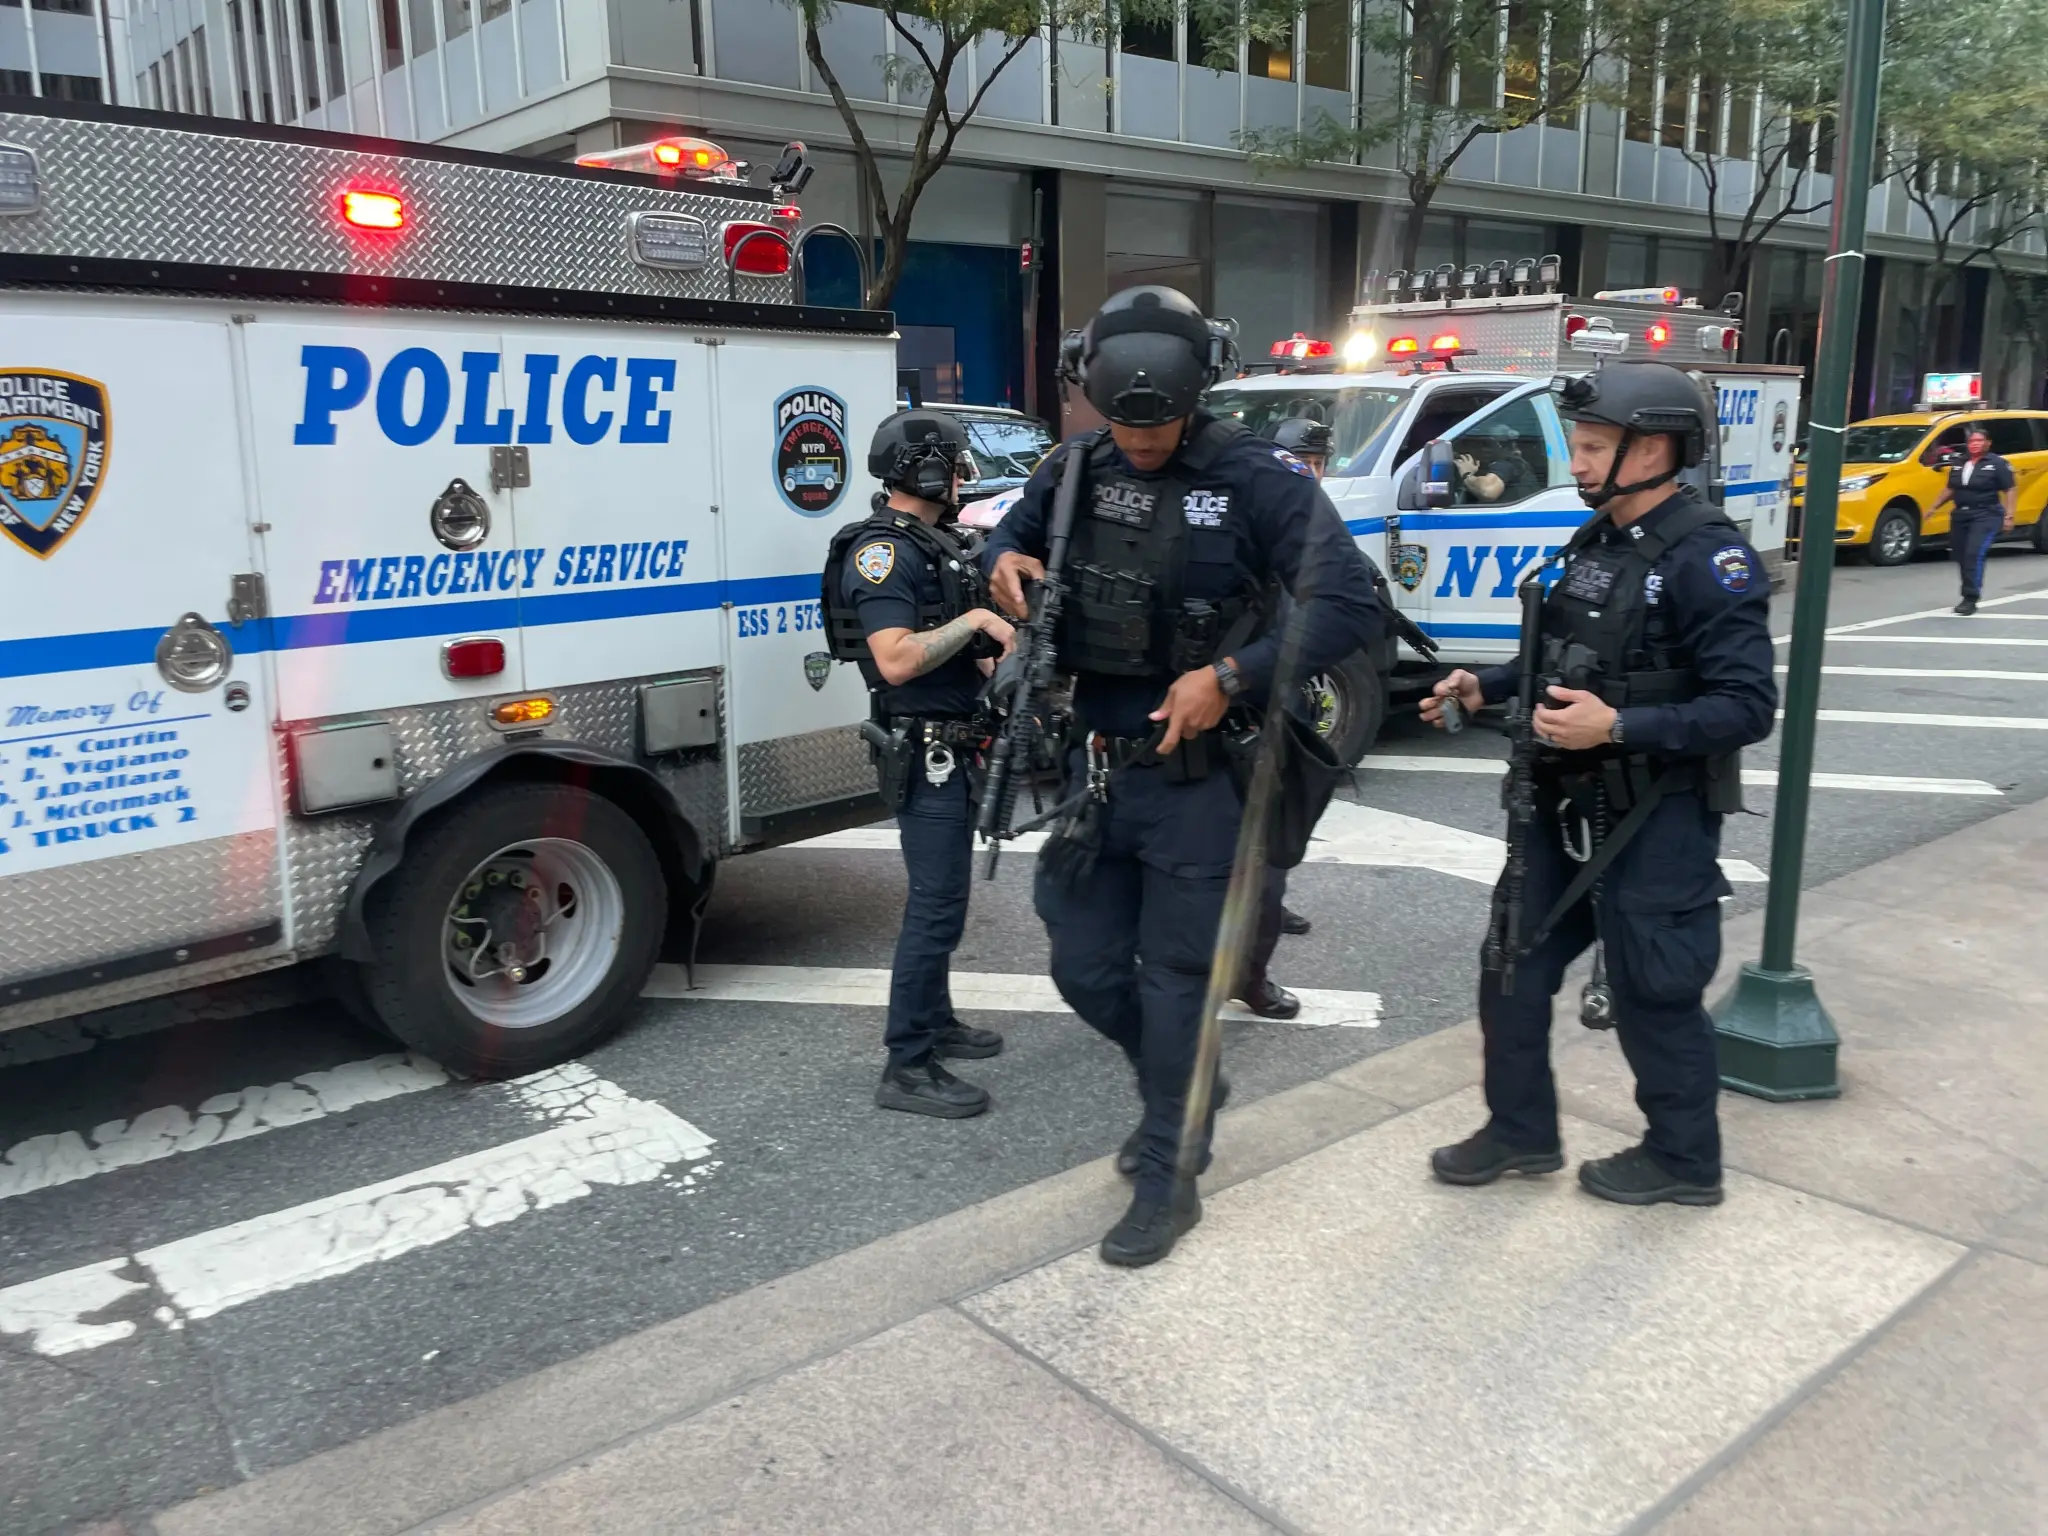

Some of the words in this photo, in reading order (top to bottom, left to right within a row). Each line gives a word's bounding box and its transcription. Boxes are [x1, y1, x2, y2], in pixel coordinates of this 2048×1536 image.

[0, 377, 70, 400] OLICE
[293, 345, 677, 446] POLICE
[0, 396, 101, 430] ARTMENT
[780, 394, 843, 428] POLICE
[1717, 389, 1759, 426] LICE
[783, 422, 842, 452] EMERGENCY
[801, 443, 826, 454] NYPD
[51, 494, 86, 533] NEW
[77, 440, 105, 488] YORK
[1093, 484, 1156, 512] POLICE
[1182, 496, 1229, 513] OLICE
[312, 547, 547, 605] EMERGENCY
[553, 540, 690, 586] SERVICE
[1434, 545, 1567, 598] NYP
[738, 608, 769, 638] ESS
[777, 606, 787, 634] 2
[6, 703, 116, 728] Memory
[127, 690, 166, 714] Of
[27, 744, 62, 760] M.
[78, 730, 178, 753] Curtin
[21, 767, 46, 783] J.
[63, 748, 190, 775] Vigiano
[11, 810, 33, 829] J.
[44, 785, 191, 823] McCormack
[30, 813, 158, 848] TRUCK
[177, 806, 199, 823] 2
